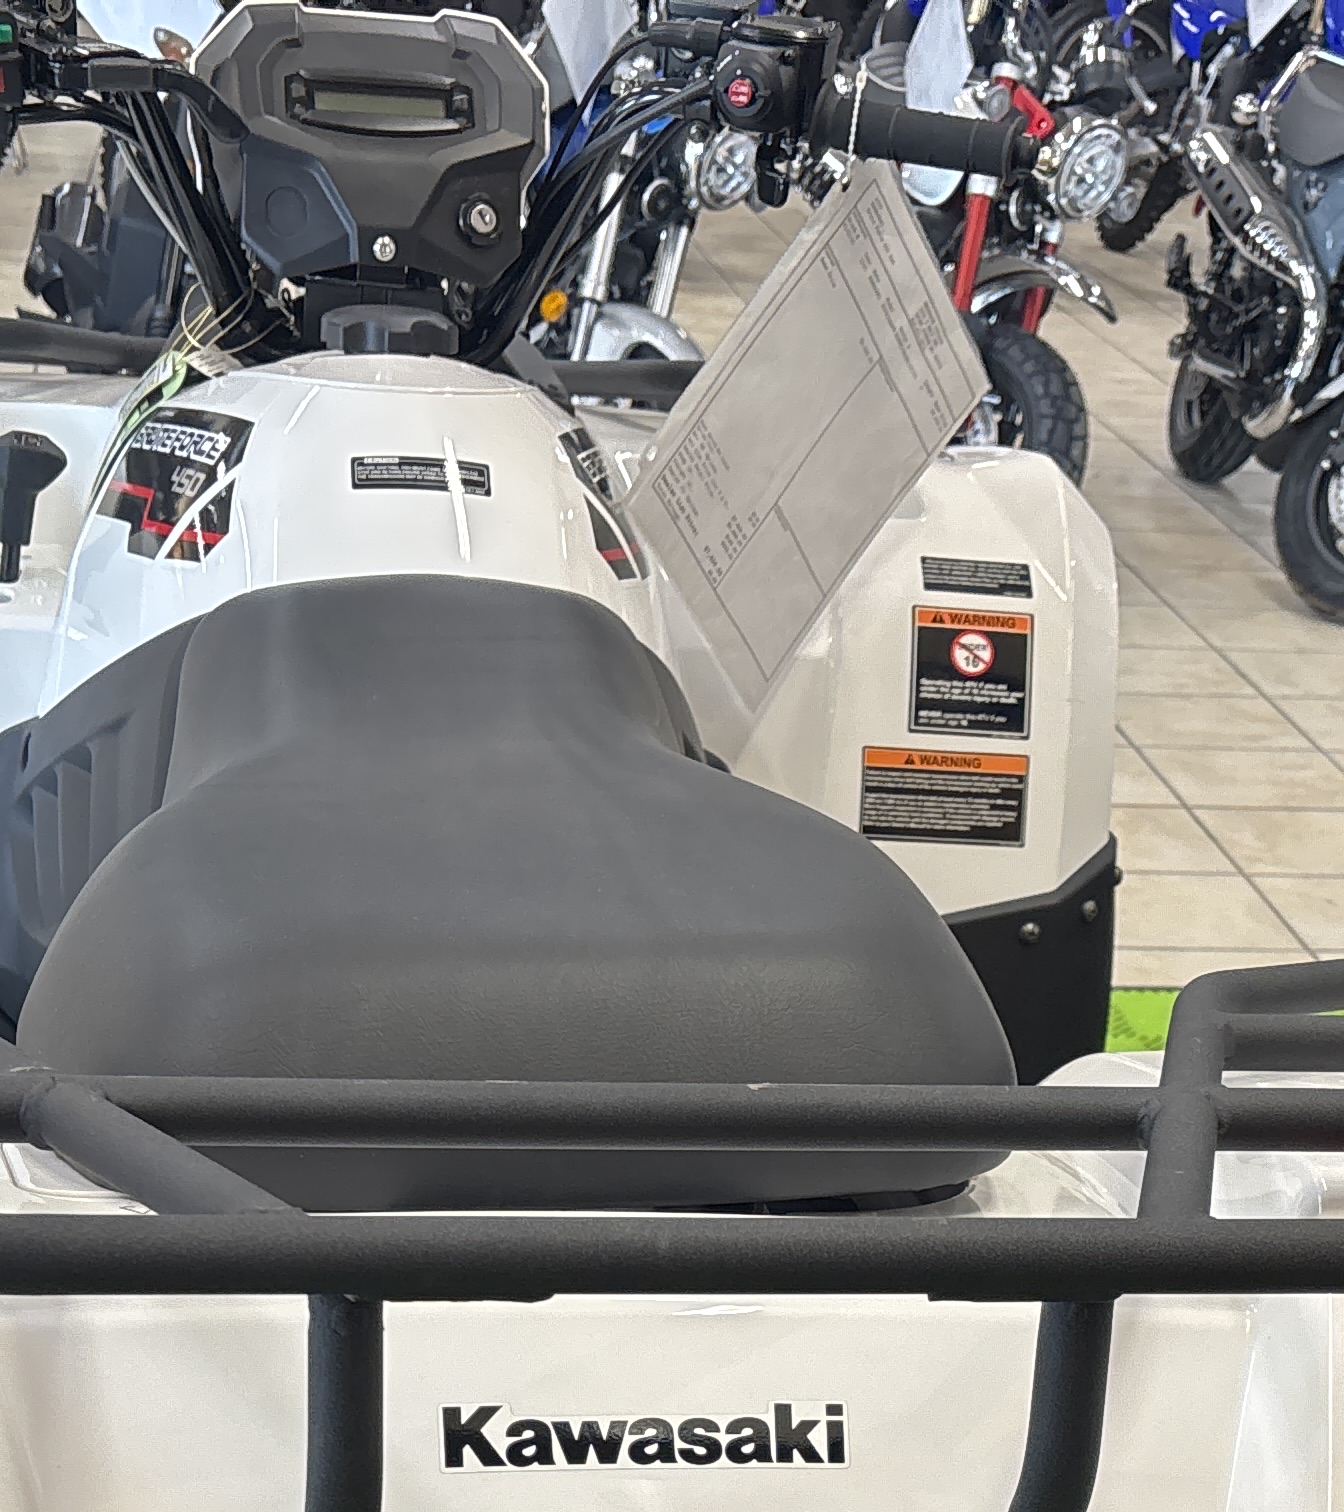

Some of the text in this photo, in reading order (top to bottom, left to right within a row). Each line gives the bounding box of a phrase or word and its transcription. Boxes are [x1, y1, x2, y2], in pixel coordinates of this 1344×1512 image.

[171, 465, 207, 497] 450
[949, 612, 1016, 629] WARNING
[963, 655, 980, 668] 16
[919, 755, 982, 769] WARNING
[441, 1403, 846, 1469] Kawasaki
